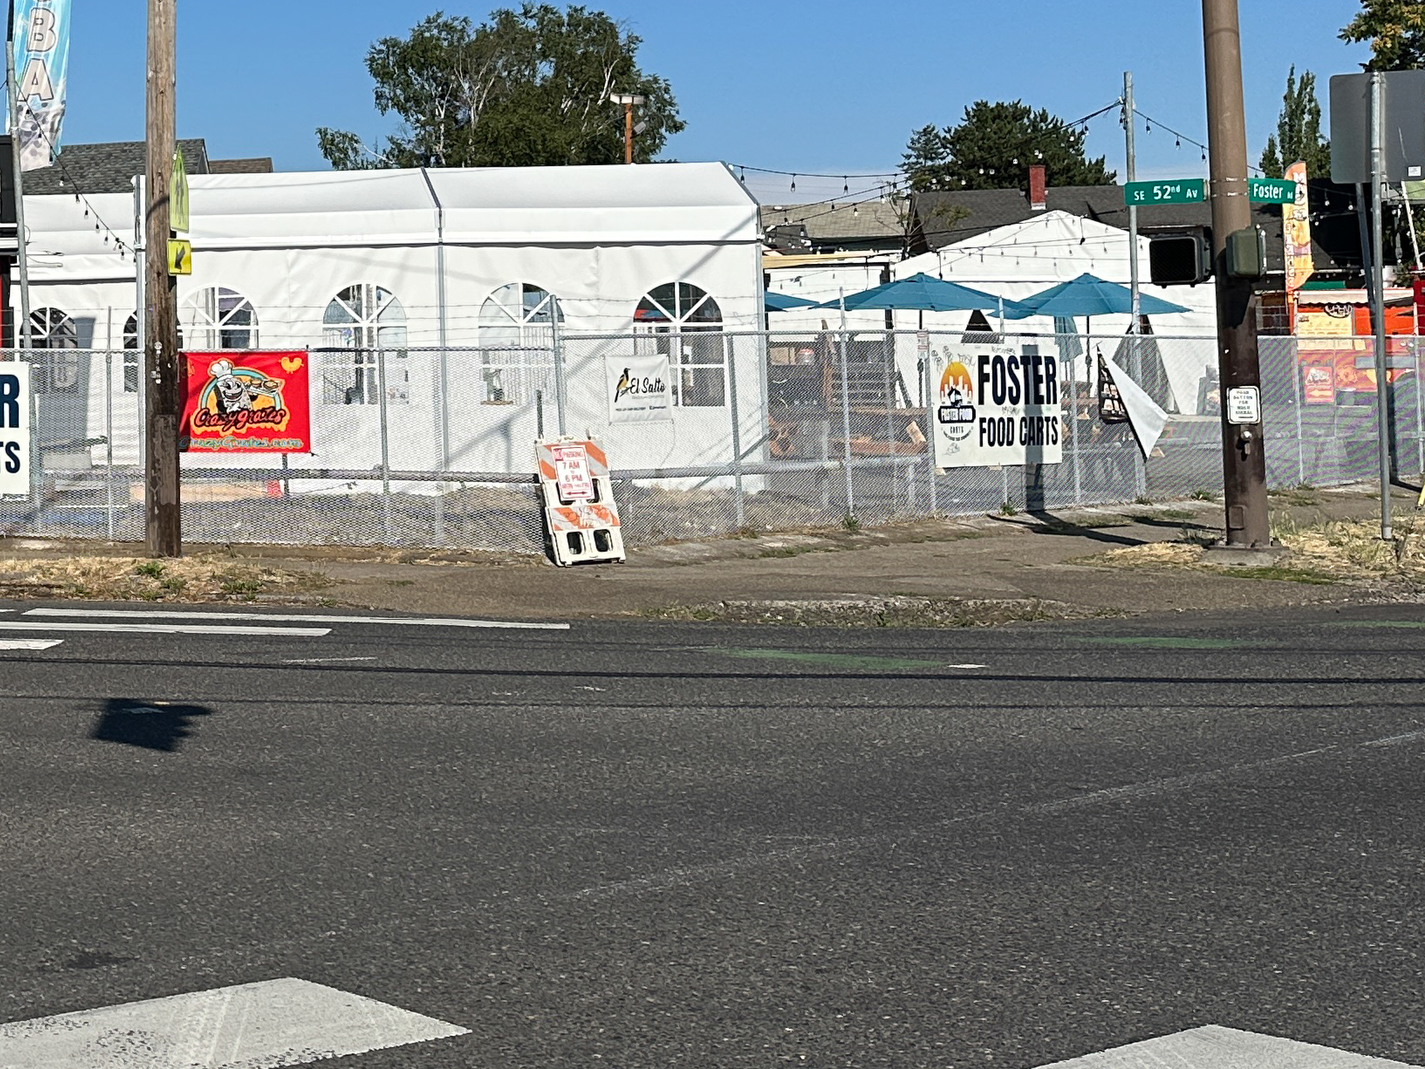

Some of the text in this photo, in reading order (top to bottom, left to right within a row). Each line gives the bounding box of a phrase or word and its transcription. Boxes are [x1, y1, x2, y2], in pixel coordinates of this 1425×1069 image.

[1133, 190, 1145, 201] SE
[1152, 184, 1181, 200] 52nd
[1253, 183, 1284, 199] Foster
[629, 376, 666, 394] El Salto
[977, 354, 1058, 406] FOSTER
[979, 415, 1059, 448] FOOD CARTS
[562, 461, 580, 470] 7 AM
[571, 474, 583, 482] PM
